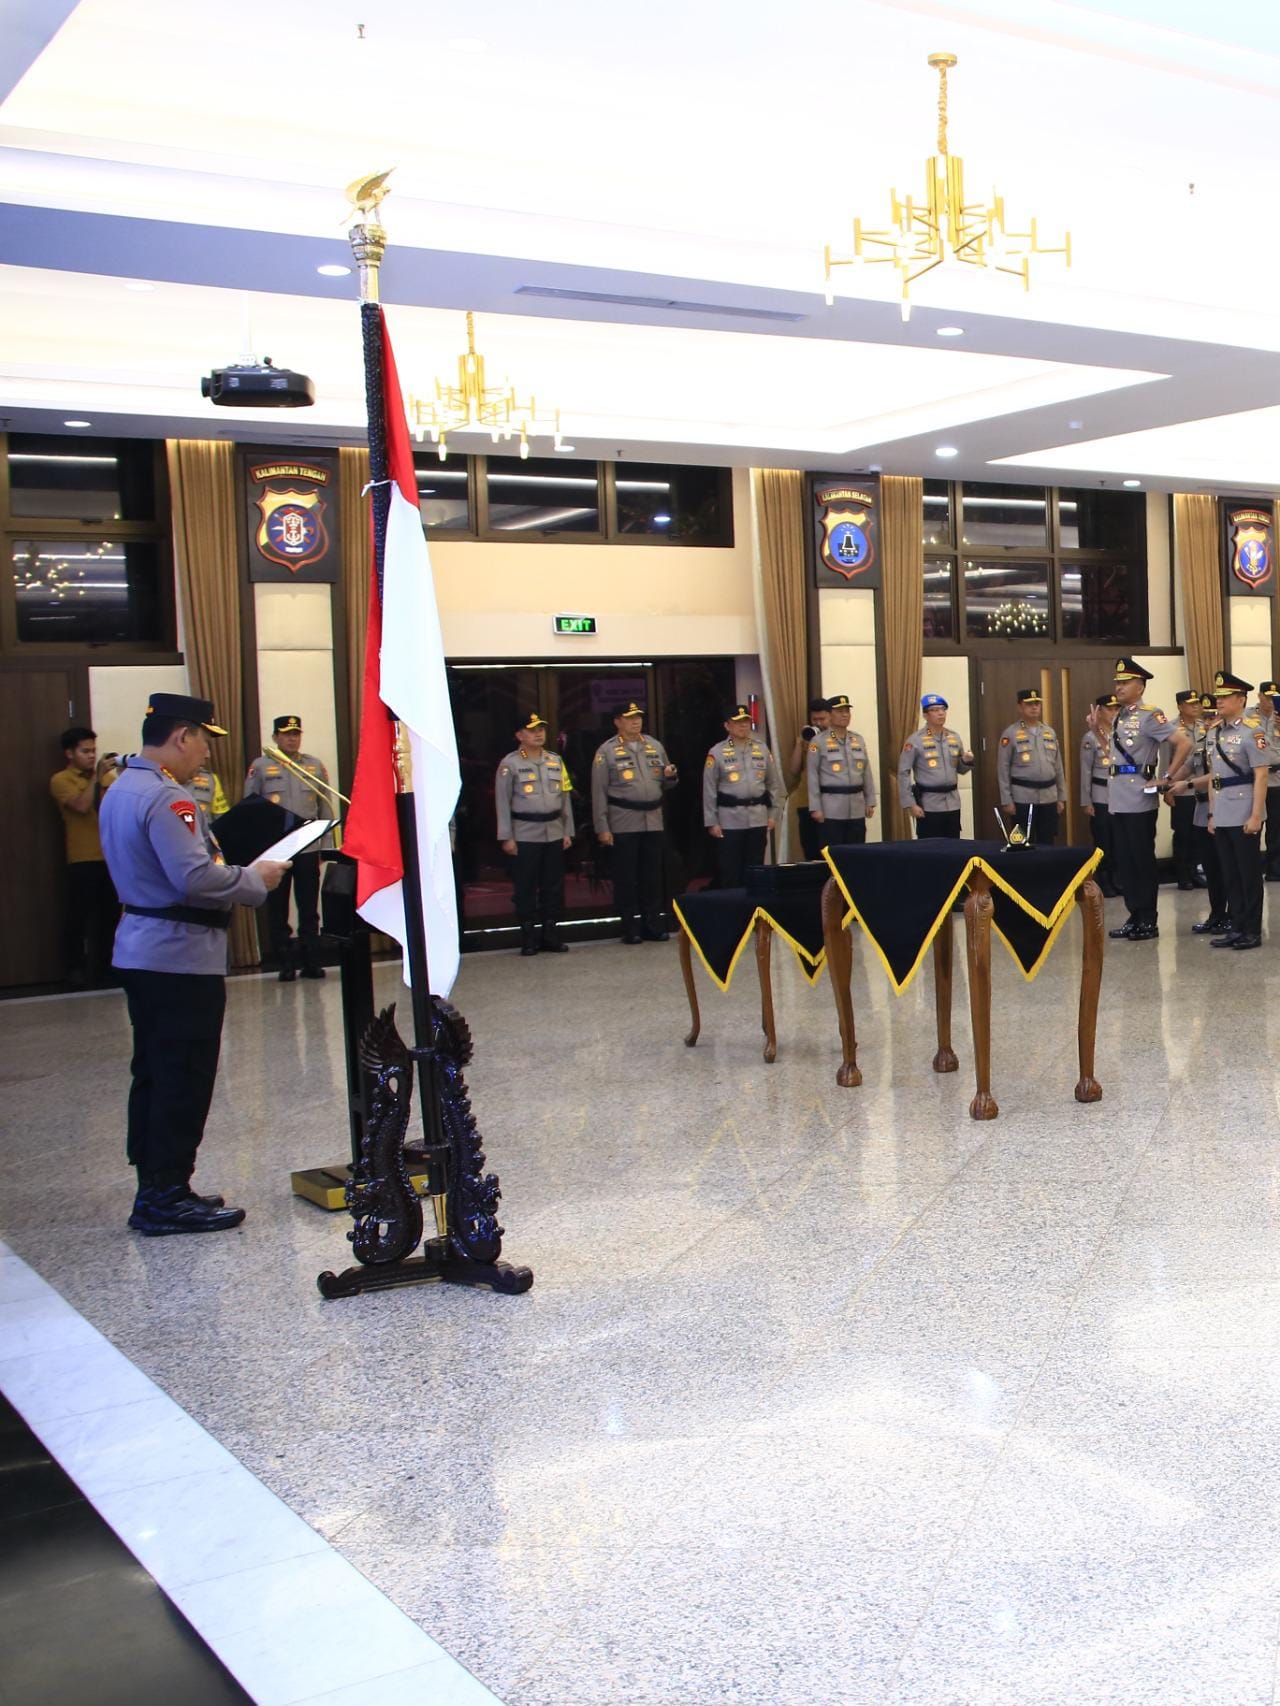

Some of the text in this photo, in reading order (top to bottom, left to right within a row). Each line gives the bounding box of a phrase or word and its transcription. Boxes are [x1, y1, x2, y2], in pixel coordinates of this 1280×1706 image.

[255, 466, 327, 481] KALIMANTAN TENGAH
[561, 619, 592, 631] EXIT
